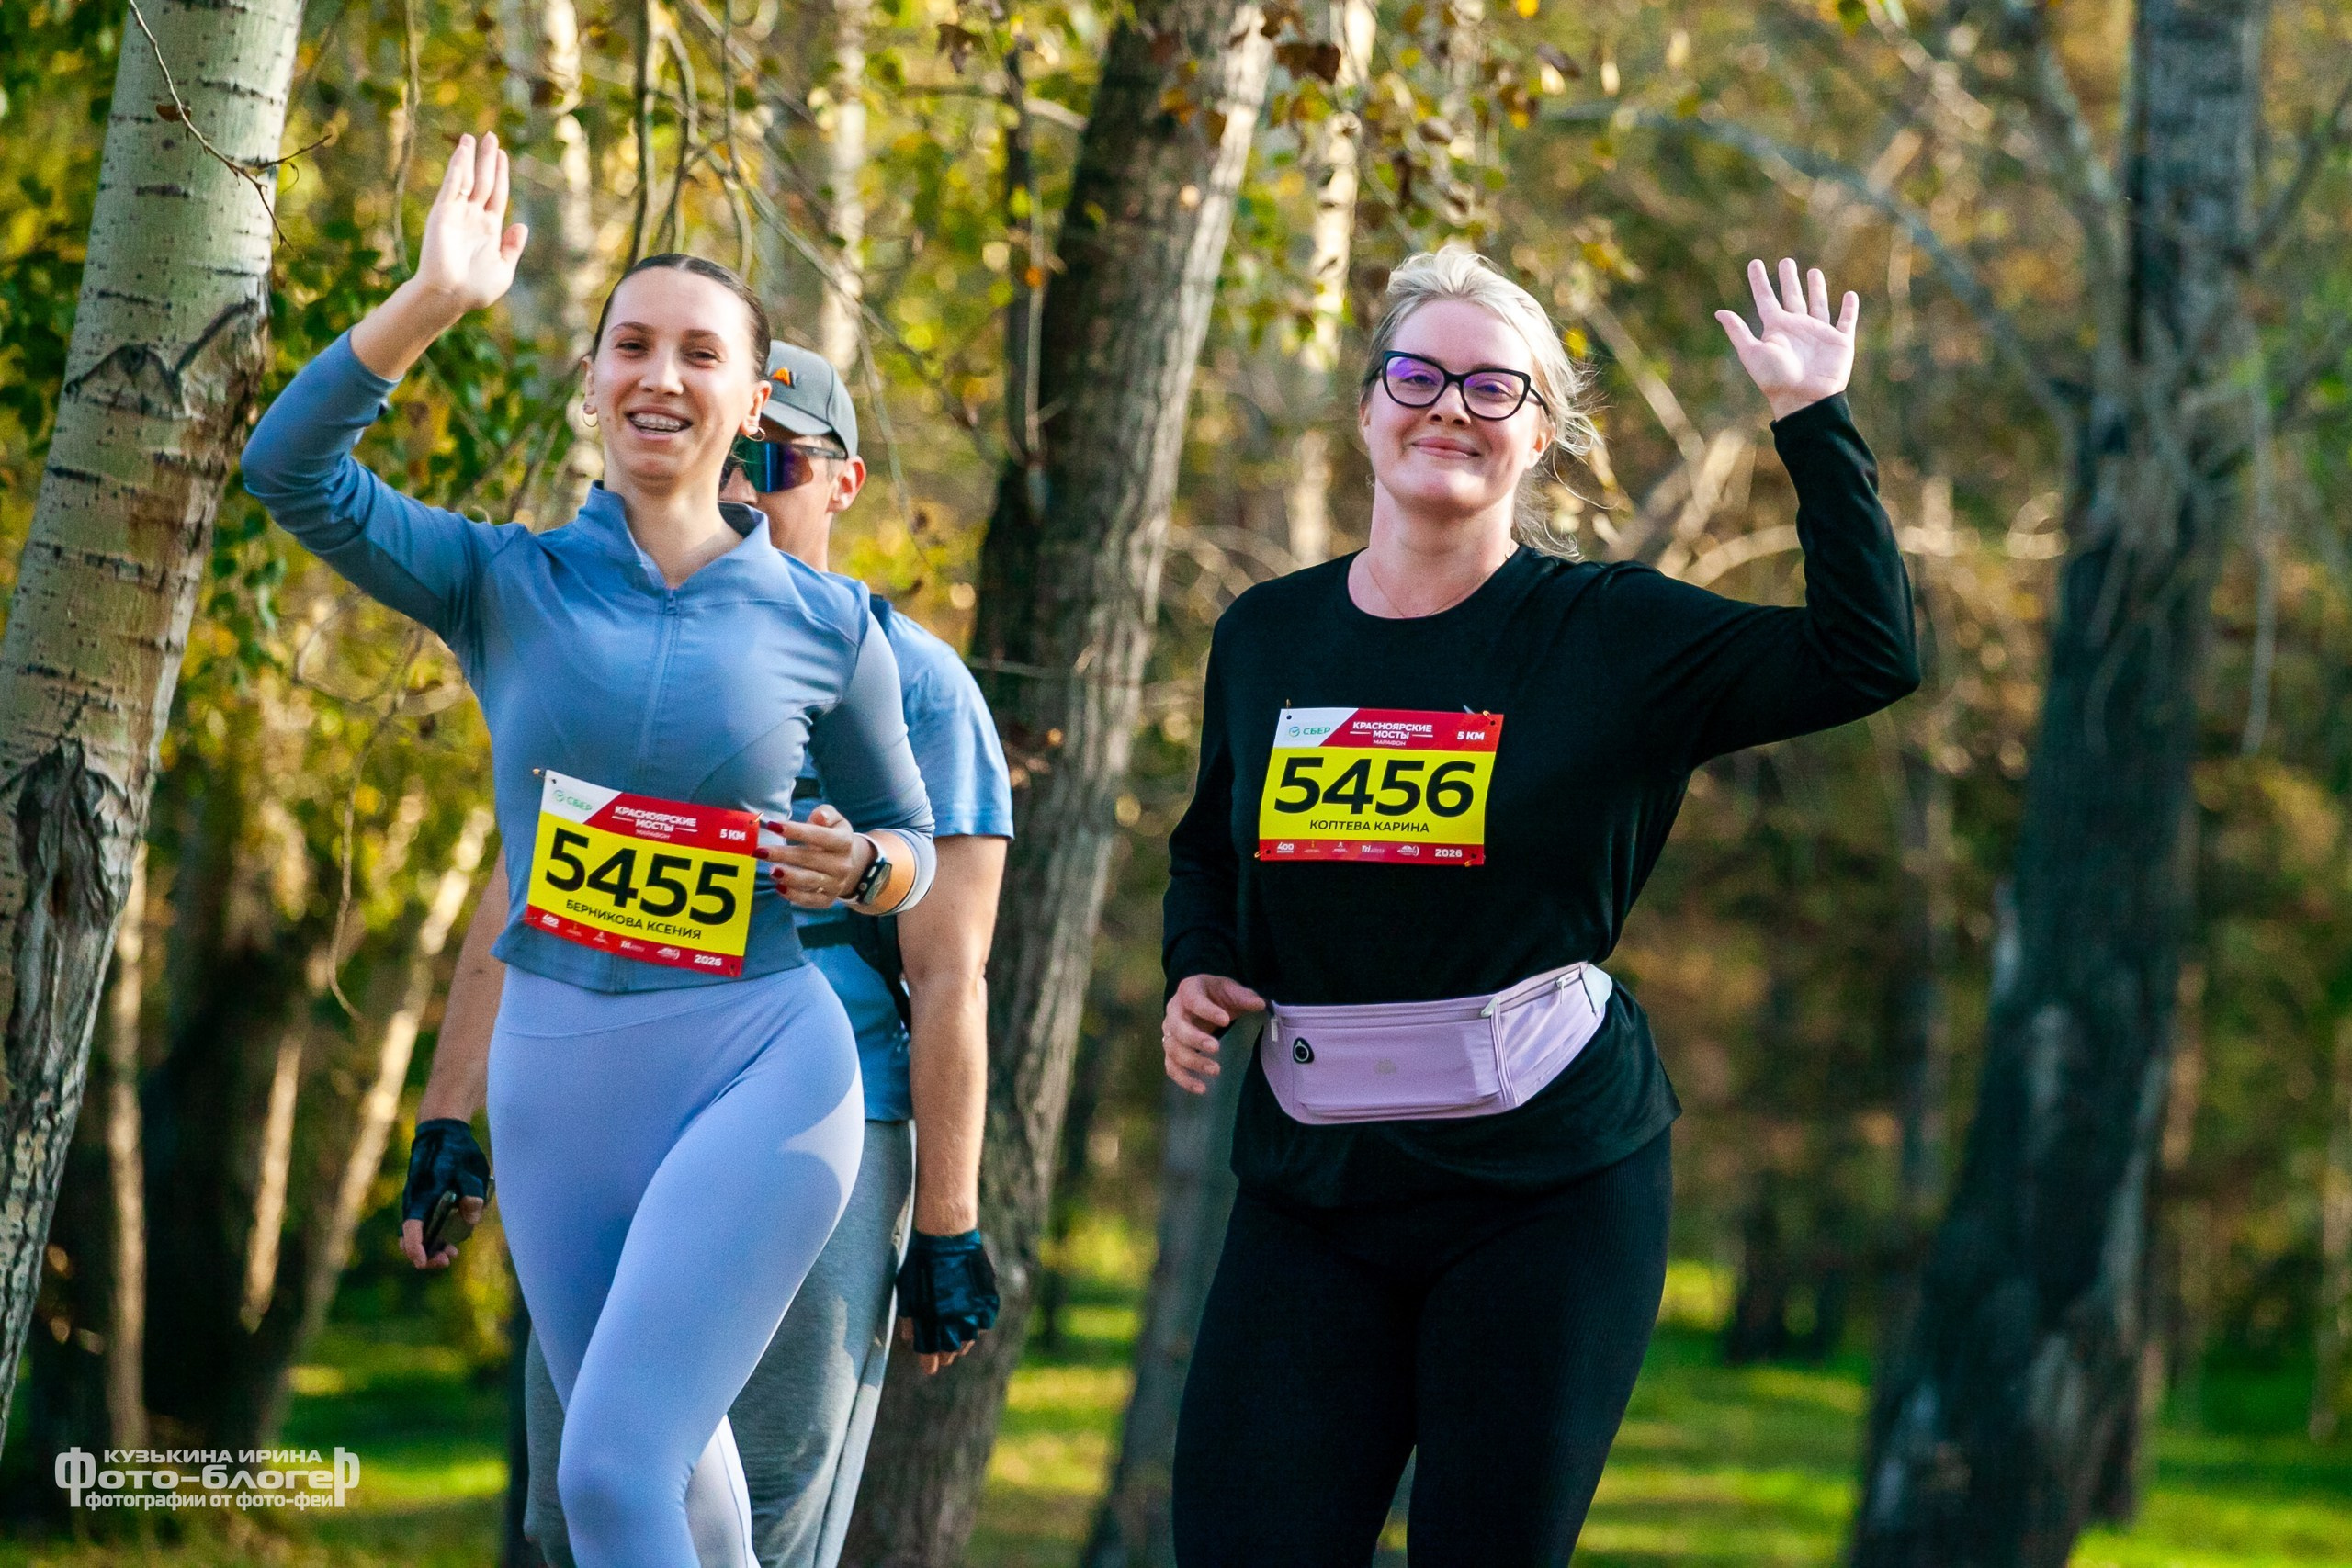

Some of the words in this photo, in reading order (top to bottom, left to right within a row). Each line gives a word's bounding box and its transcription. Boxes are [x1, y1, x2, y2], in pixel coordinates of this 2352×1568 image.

[1303, 727, 1330, 736] СБЕР
[1352, 721, 1432, 733] КРАСНОЯРСКИЕ
[1373, 730, 1409, 739] МОСТЫ
[1457, 730, 1465, 740] 5
[1467, 731, 1485, 740] КМ
[1273, 756, 1476, 818] 5456
[566, 795, 592, 812] СБЕР
[615, 805, 697, 828] КРАСНОЯРСКИЕ
[635, 818, 674, 832] МОСТЫ
[1309, 819, 1371, 831] КОПТЕВА
[1374, 821, 1430, 833] КАРИНА
[719, 829, 729, 840] 5
[729, 829, 746, 841] КМ
[1434, 848, 1463, 858] 2026
[545, 827, 739, 926] 5455
[566, 899, 643, 929] БЕРНИКОВА
[641, 921, 702, 940] КСЕНИЯ
[694, 953, 723, 967] 2026
